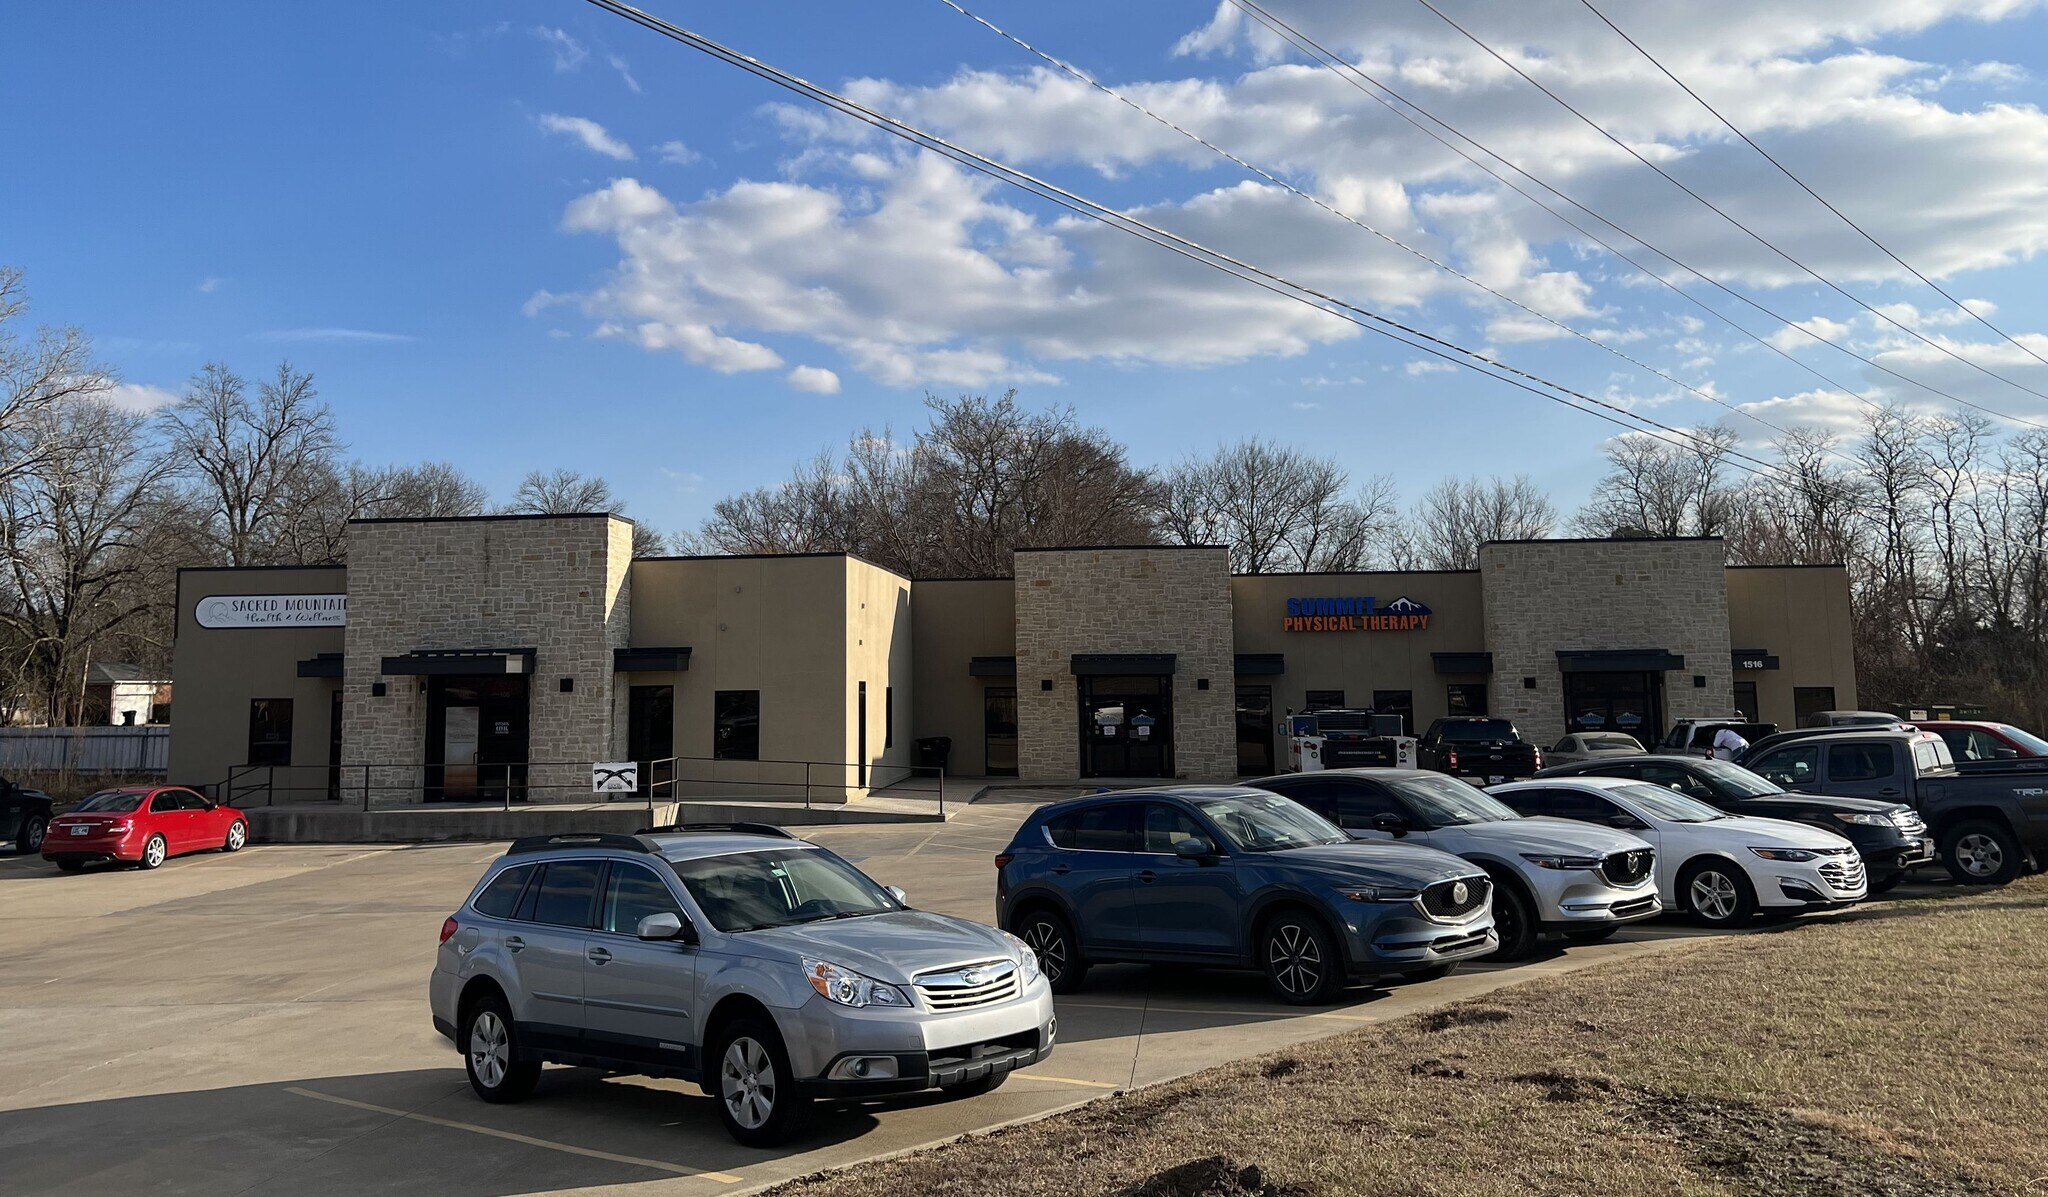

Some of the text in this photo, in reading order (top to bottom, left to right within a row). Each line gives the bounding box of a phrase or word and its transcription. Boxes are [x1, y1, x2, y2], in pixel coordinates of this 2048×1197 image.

[232, 600, 278, 612] SACRED
[1286, 597, 1376, 616] SUMMIT
[245, 612, 282, 623] Health
[295, 612, 341, 622] Wellness
[1284, 615, 1428, 631] PHYSICAL THERAPY
[1743, 660, 1763, 668] 1516
[2012, 788, 2044, 796] TRD
